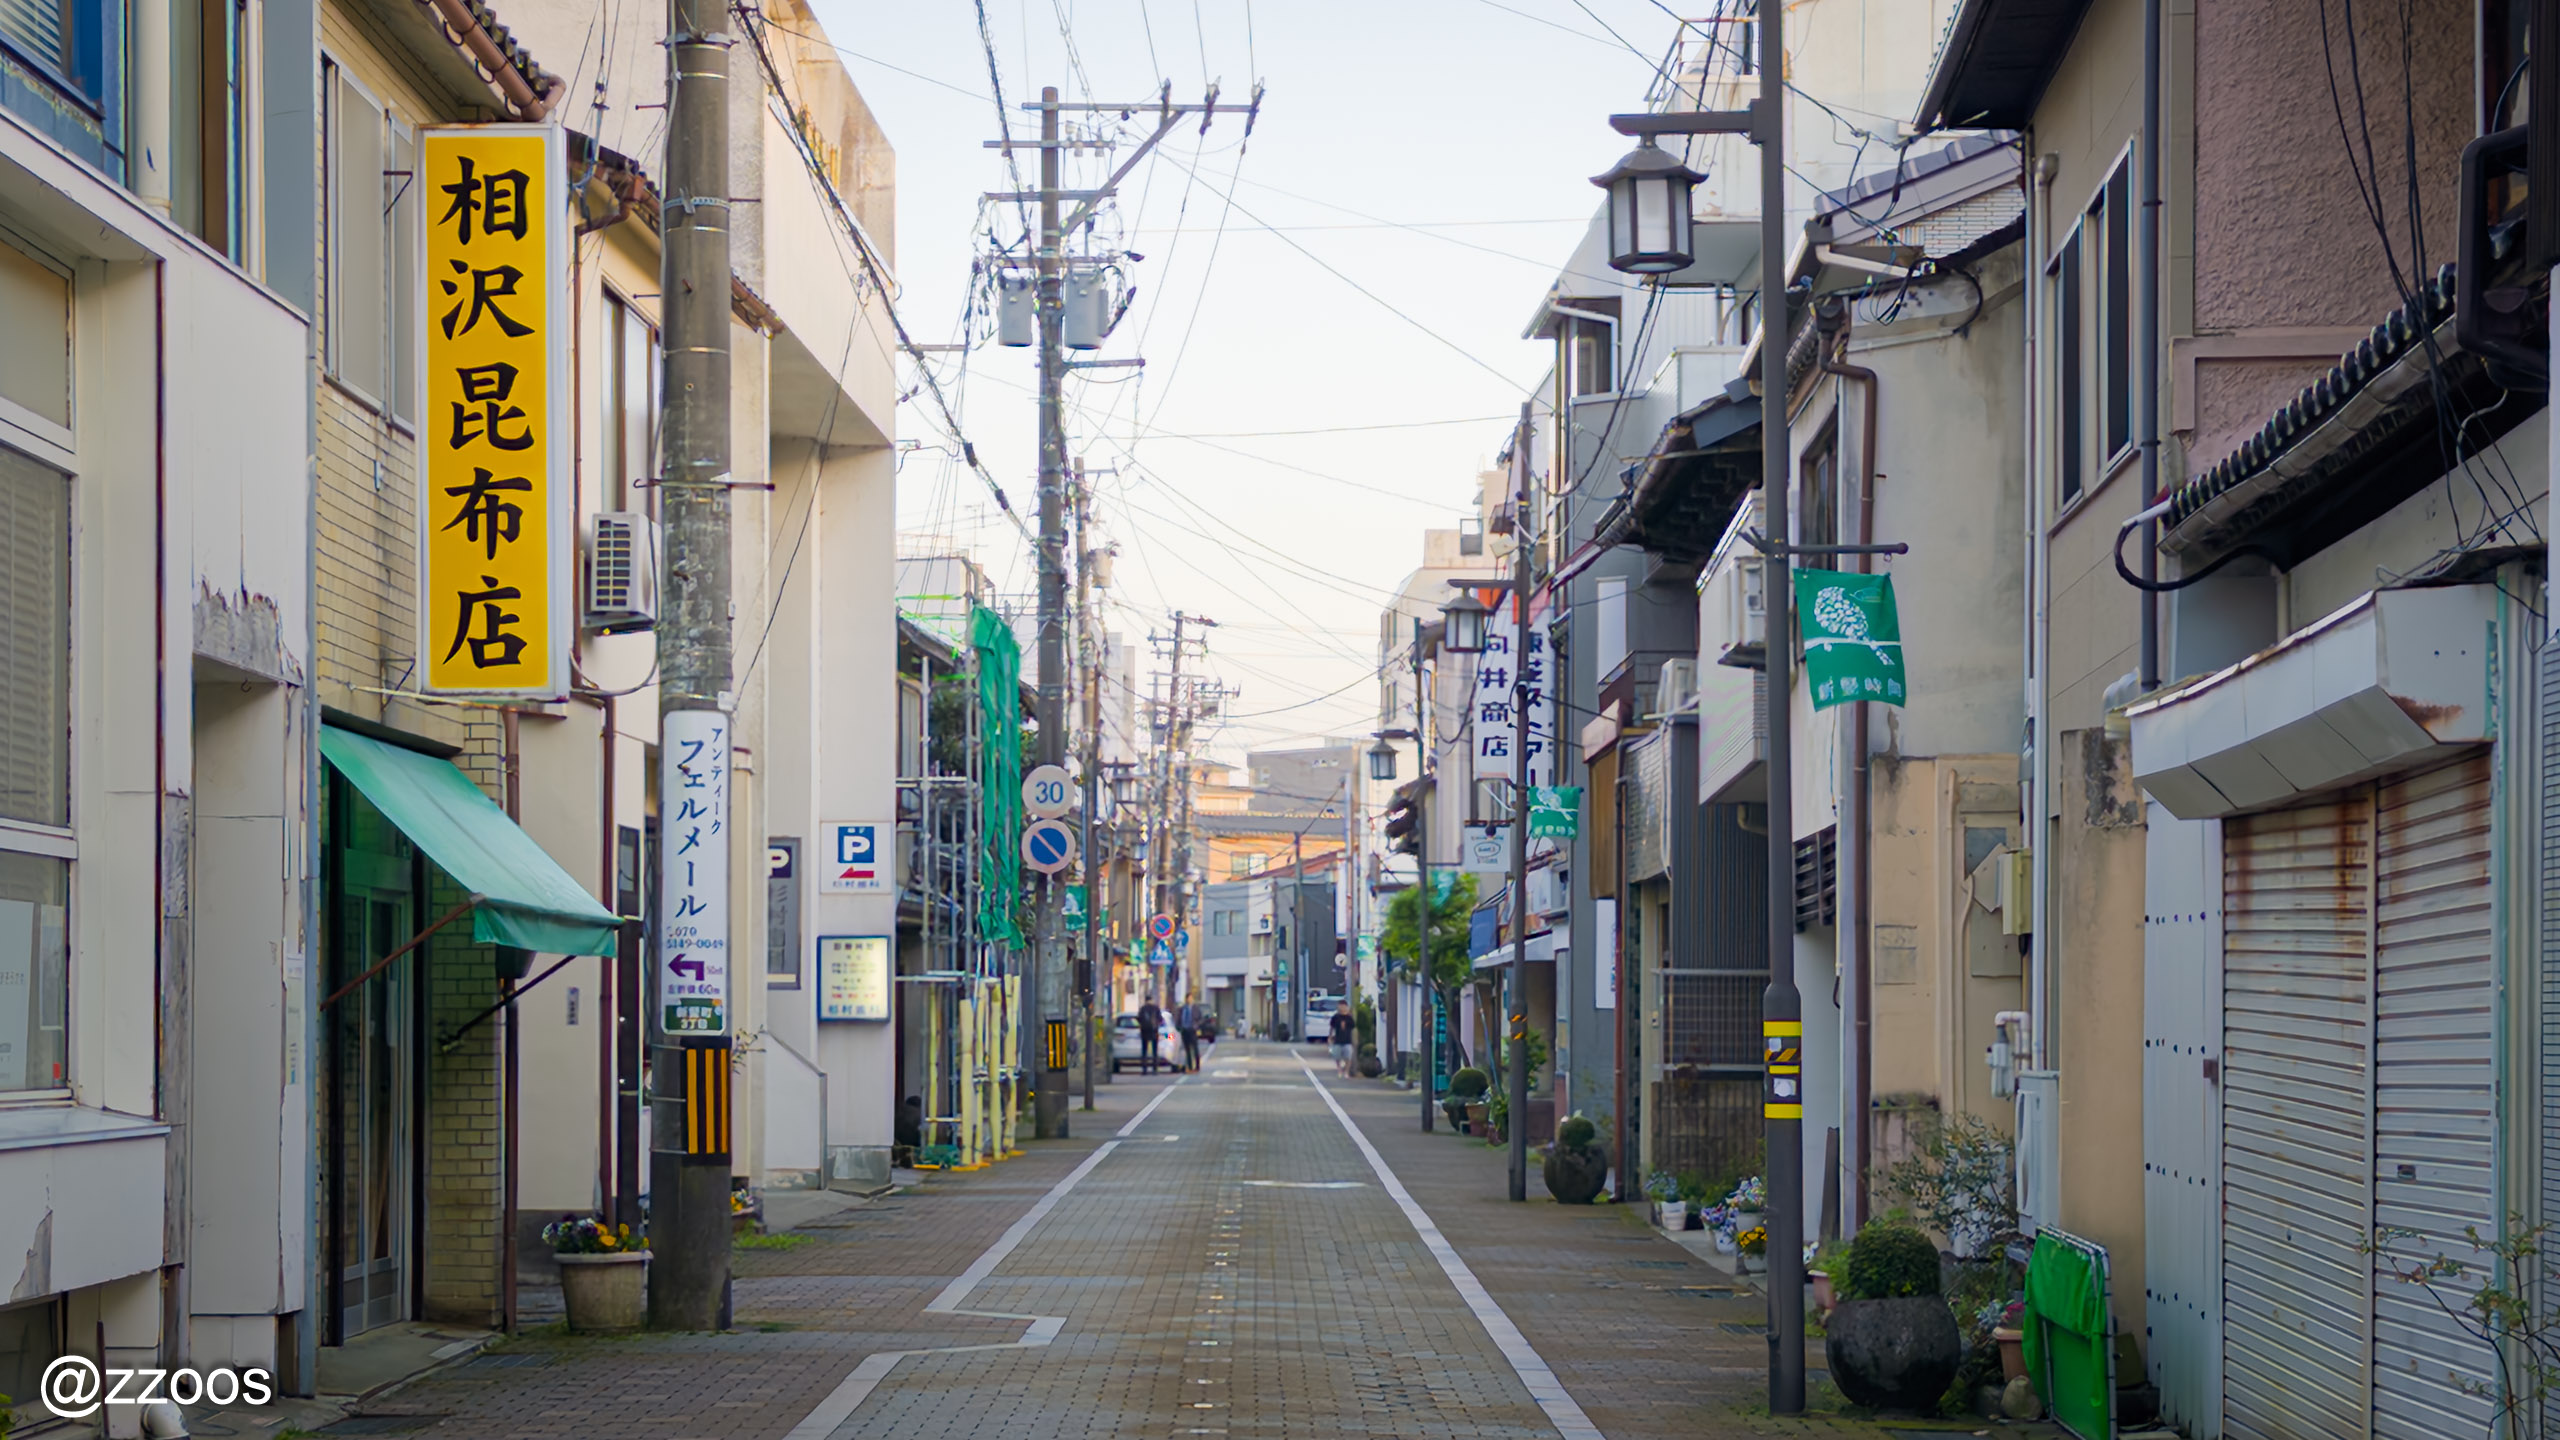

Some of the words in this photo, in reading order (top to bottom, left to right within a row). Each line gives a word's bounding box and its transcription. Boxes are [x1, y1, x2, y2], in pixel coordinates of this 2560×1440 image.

[437, 156, 535, 669] 相沢昆布店
[1481, 633, 1509, 757] 向井商店
[675, 740, 708, 918] フェルメール
[711, 728, 723, 835] アンティーク
[1035, 781, 1064, 804] 30
[843, 835, 871, 861] P
